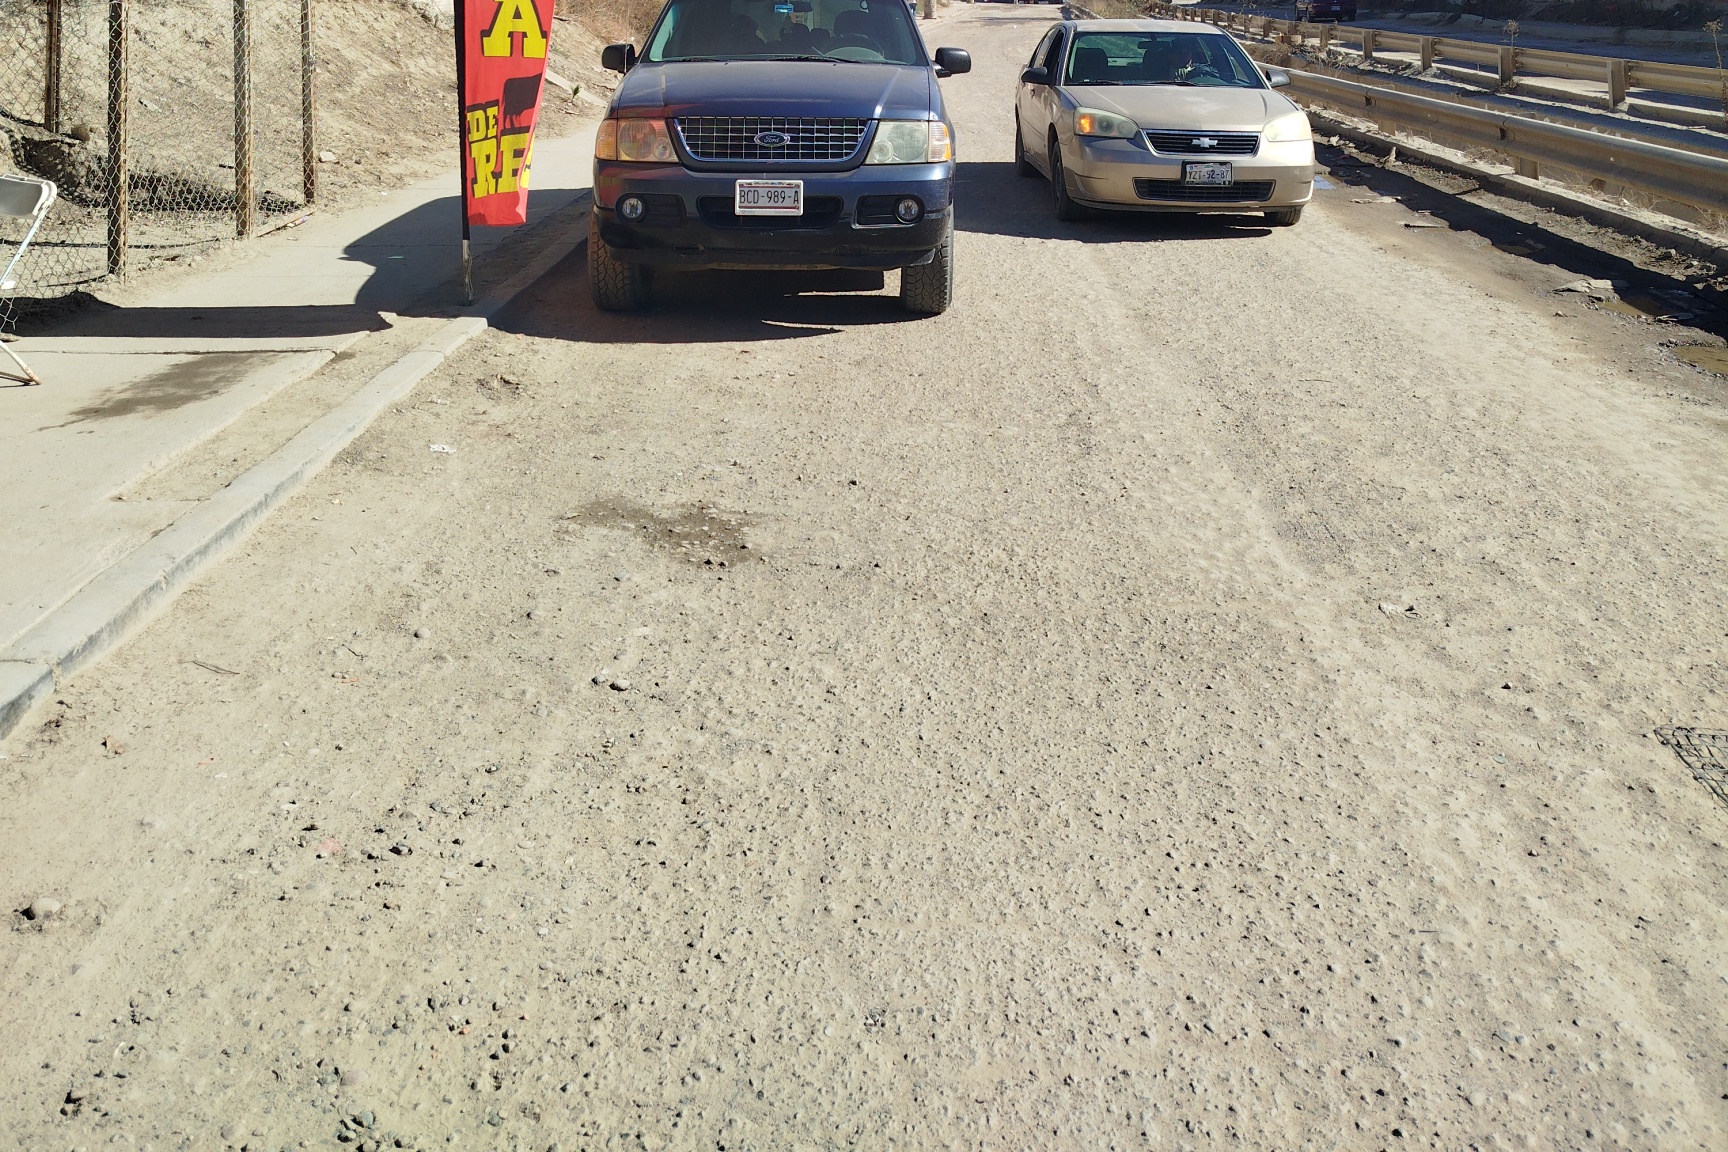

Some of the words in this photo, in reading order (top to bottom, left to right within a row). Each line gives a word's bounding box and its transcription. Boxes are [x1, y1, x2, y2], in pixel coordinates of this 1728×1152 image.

[467, 105, 498, 141] DE
[763, 135, 780, 143] Ford
[739, 189, 799, 205] BCD-989-A
